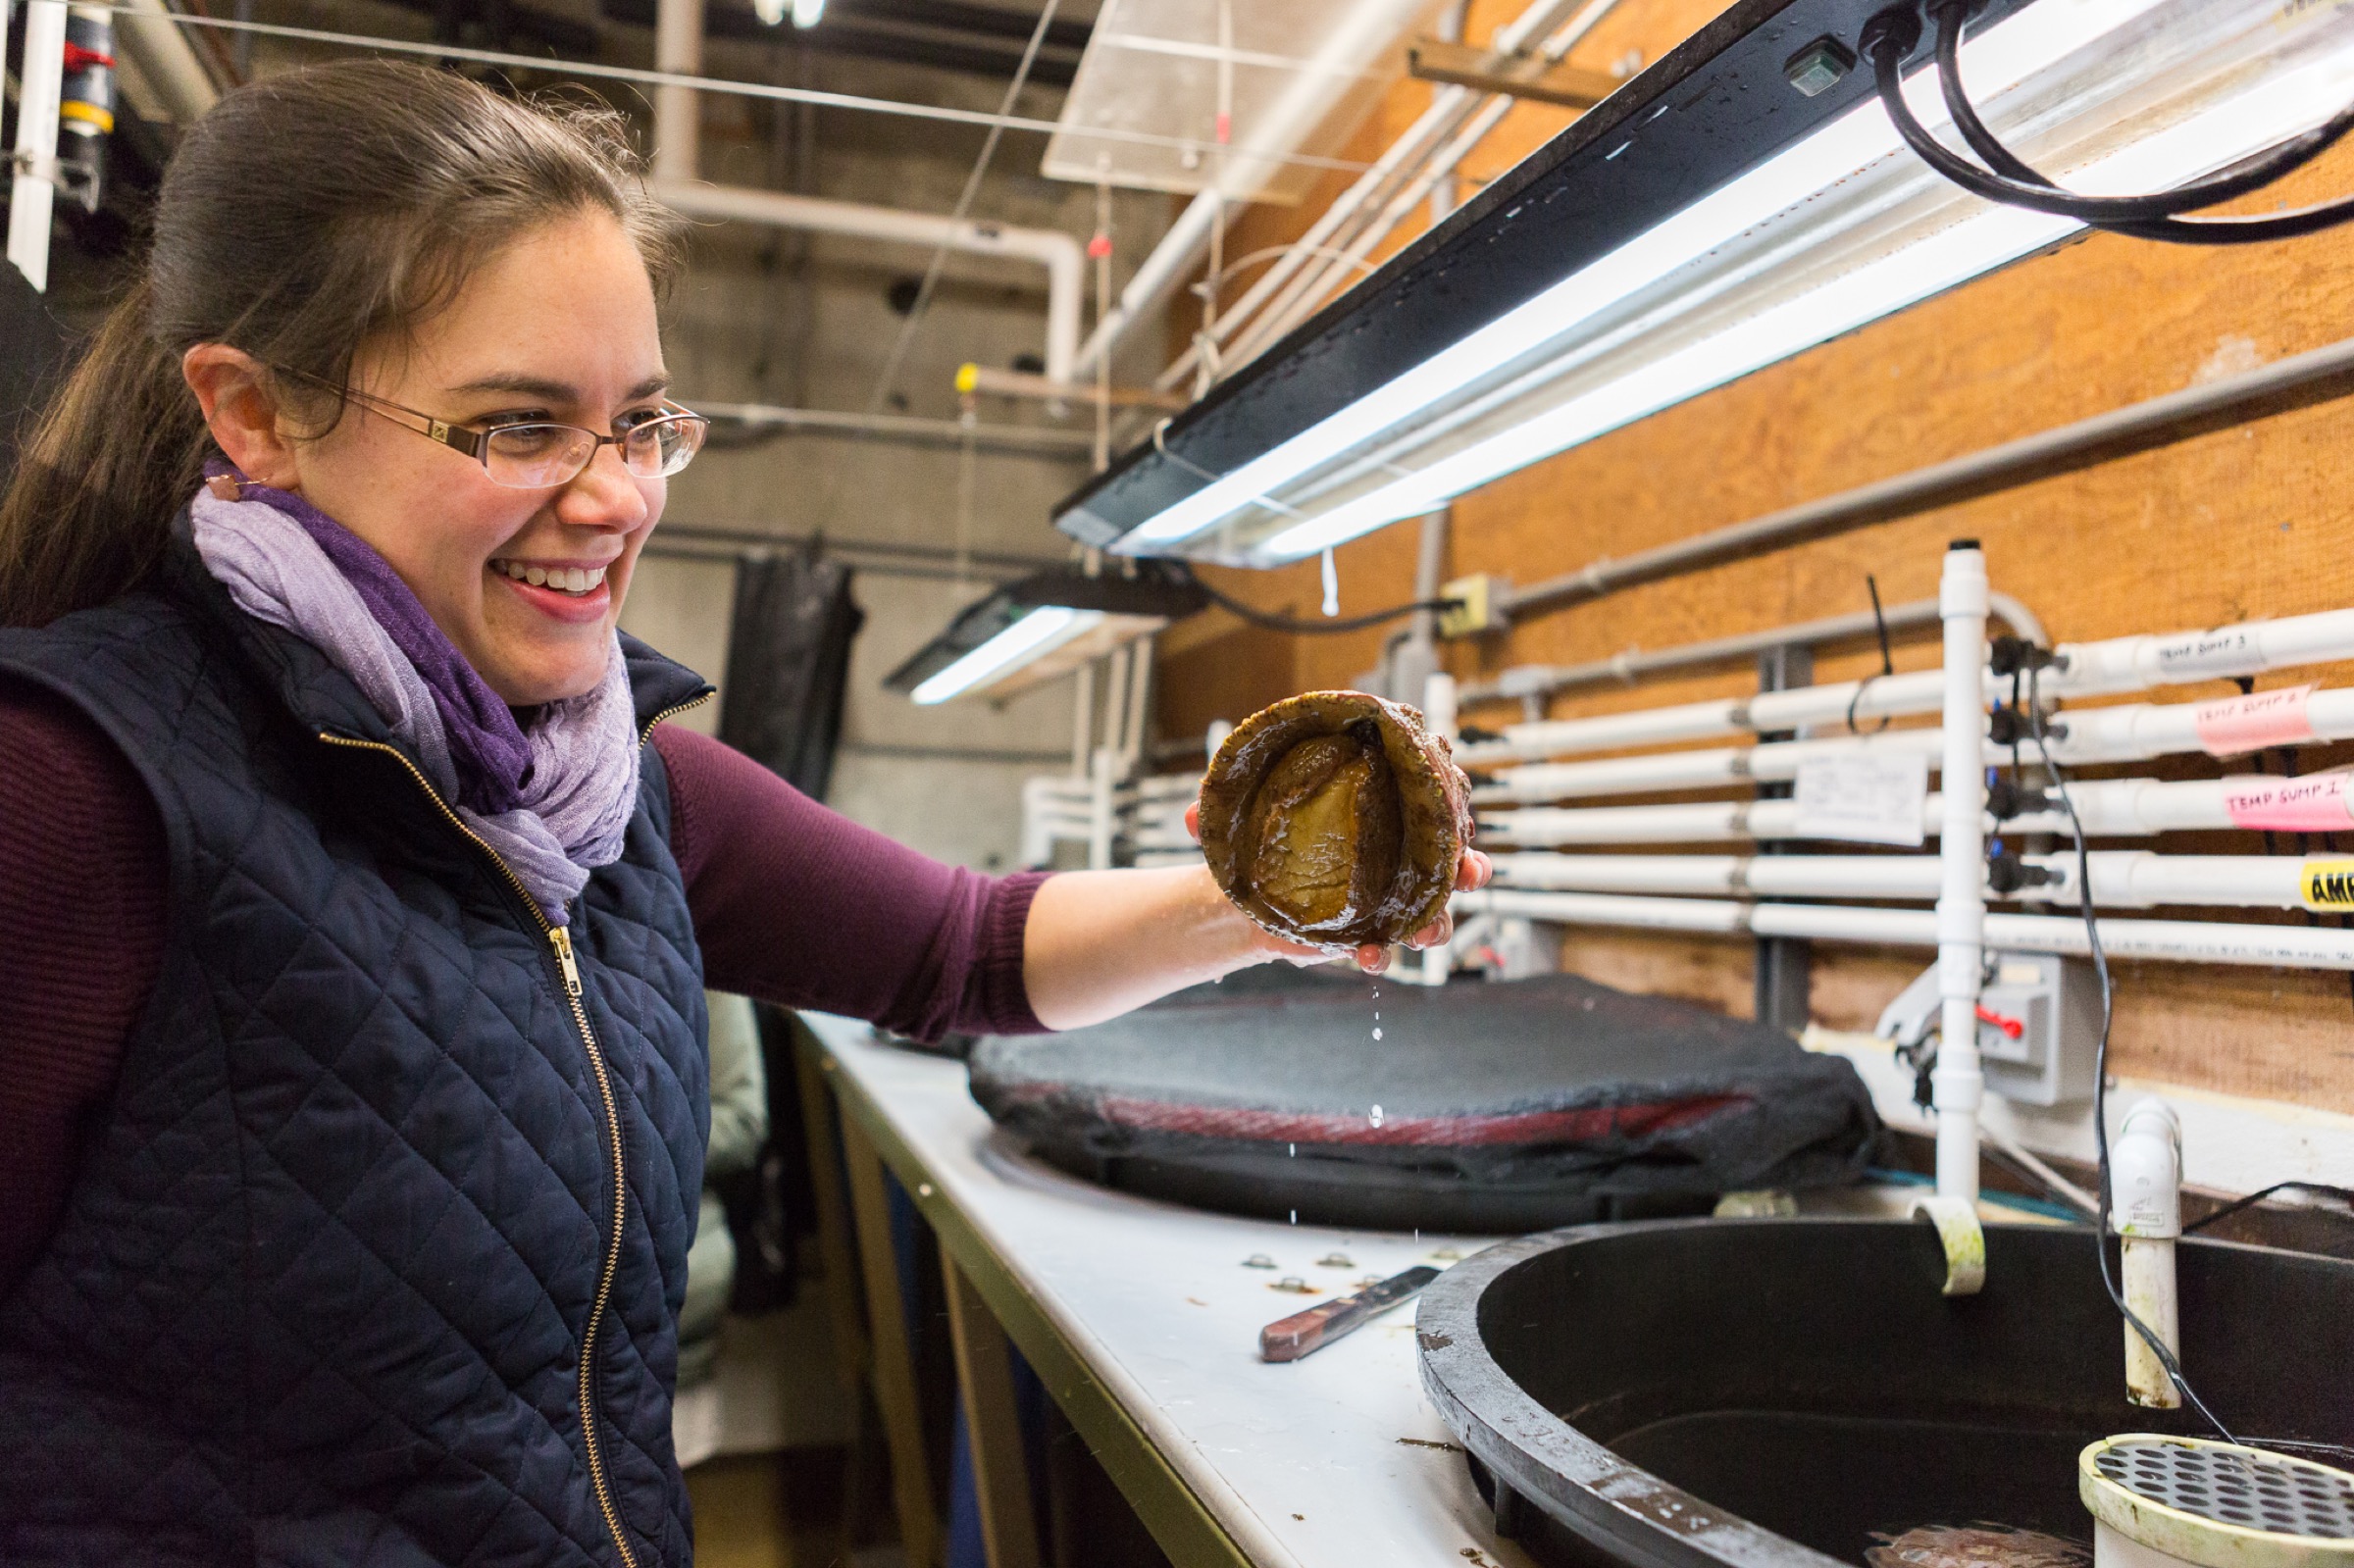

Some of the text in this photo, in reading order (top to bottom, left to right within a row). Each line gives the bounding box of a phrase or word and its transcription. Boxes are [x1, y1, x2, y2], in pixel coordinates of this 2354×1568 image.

[2237, 633, 2246, 649] 3
[2226, 791, 2273, 812] TEMP
[2278, 784, 2322, 805] SUMP
